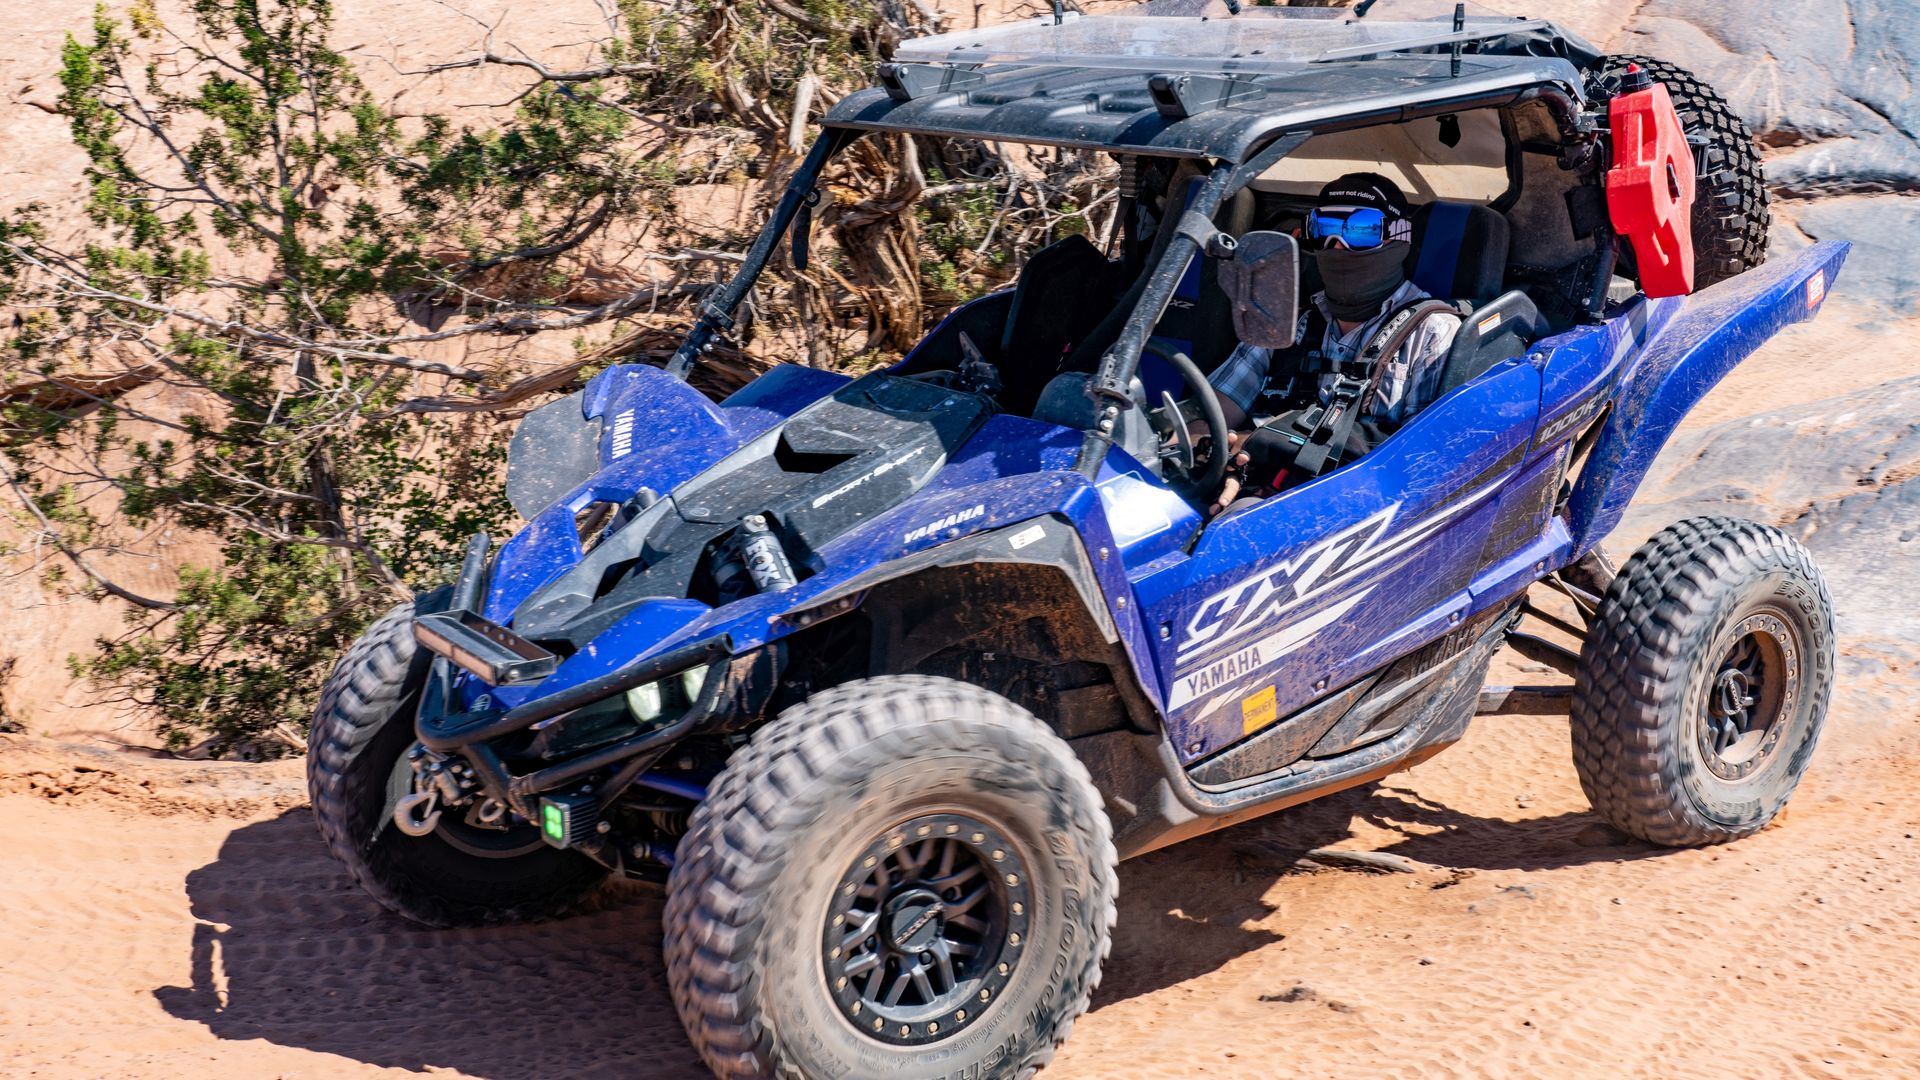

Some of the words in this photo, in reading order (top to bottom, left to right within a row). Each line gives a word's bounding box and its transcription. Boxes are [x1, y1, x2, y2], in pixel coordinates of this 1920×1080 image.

[1357, 190, 1376, 201] riding
[1168, 299, 1195, 310] XZ
[611, 408, 635, 460] YAMAHA
[1539, 394, 1599, 444] 1000R
[903, 504, 985, 544] YAMAHA
[745, 538, 782, 589] FOX
[1178, 500, 1403, 653] YXZ
[1187, 646, 1263, 698] YAMAHA
